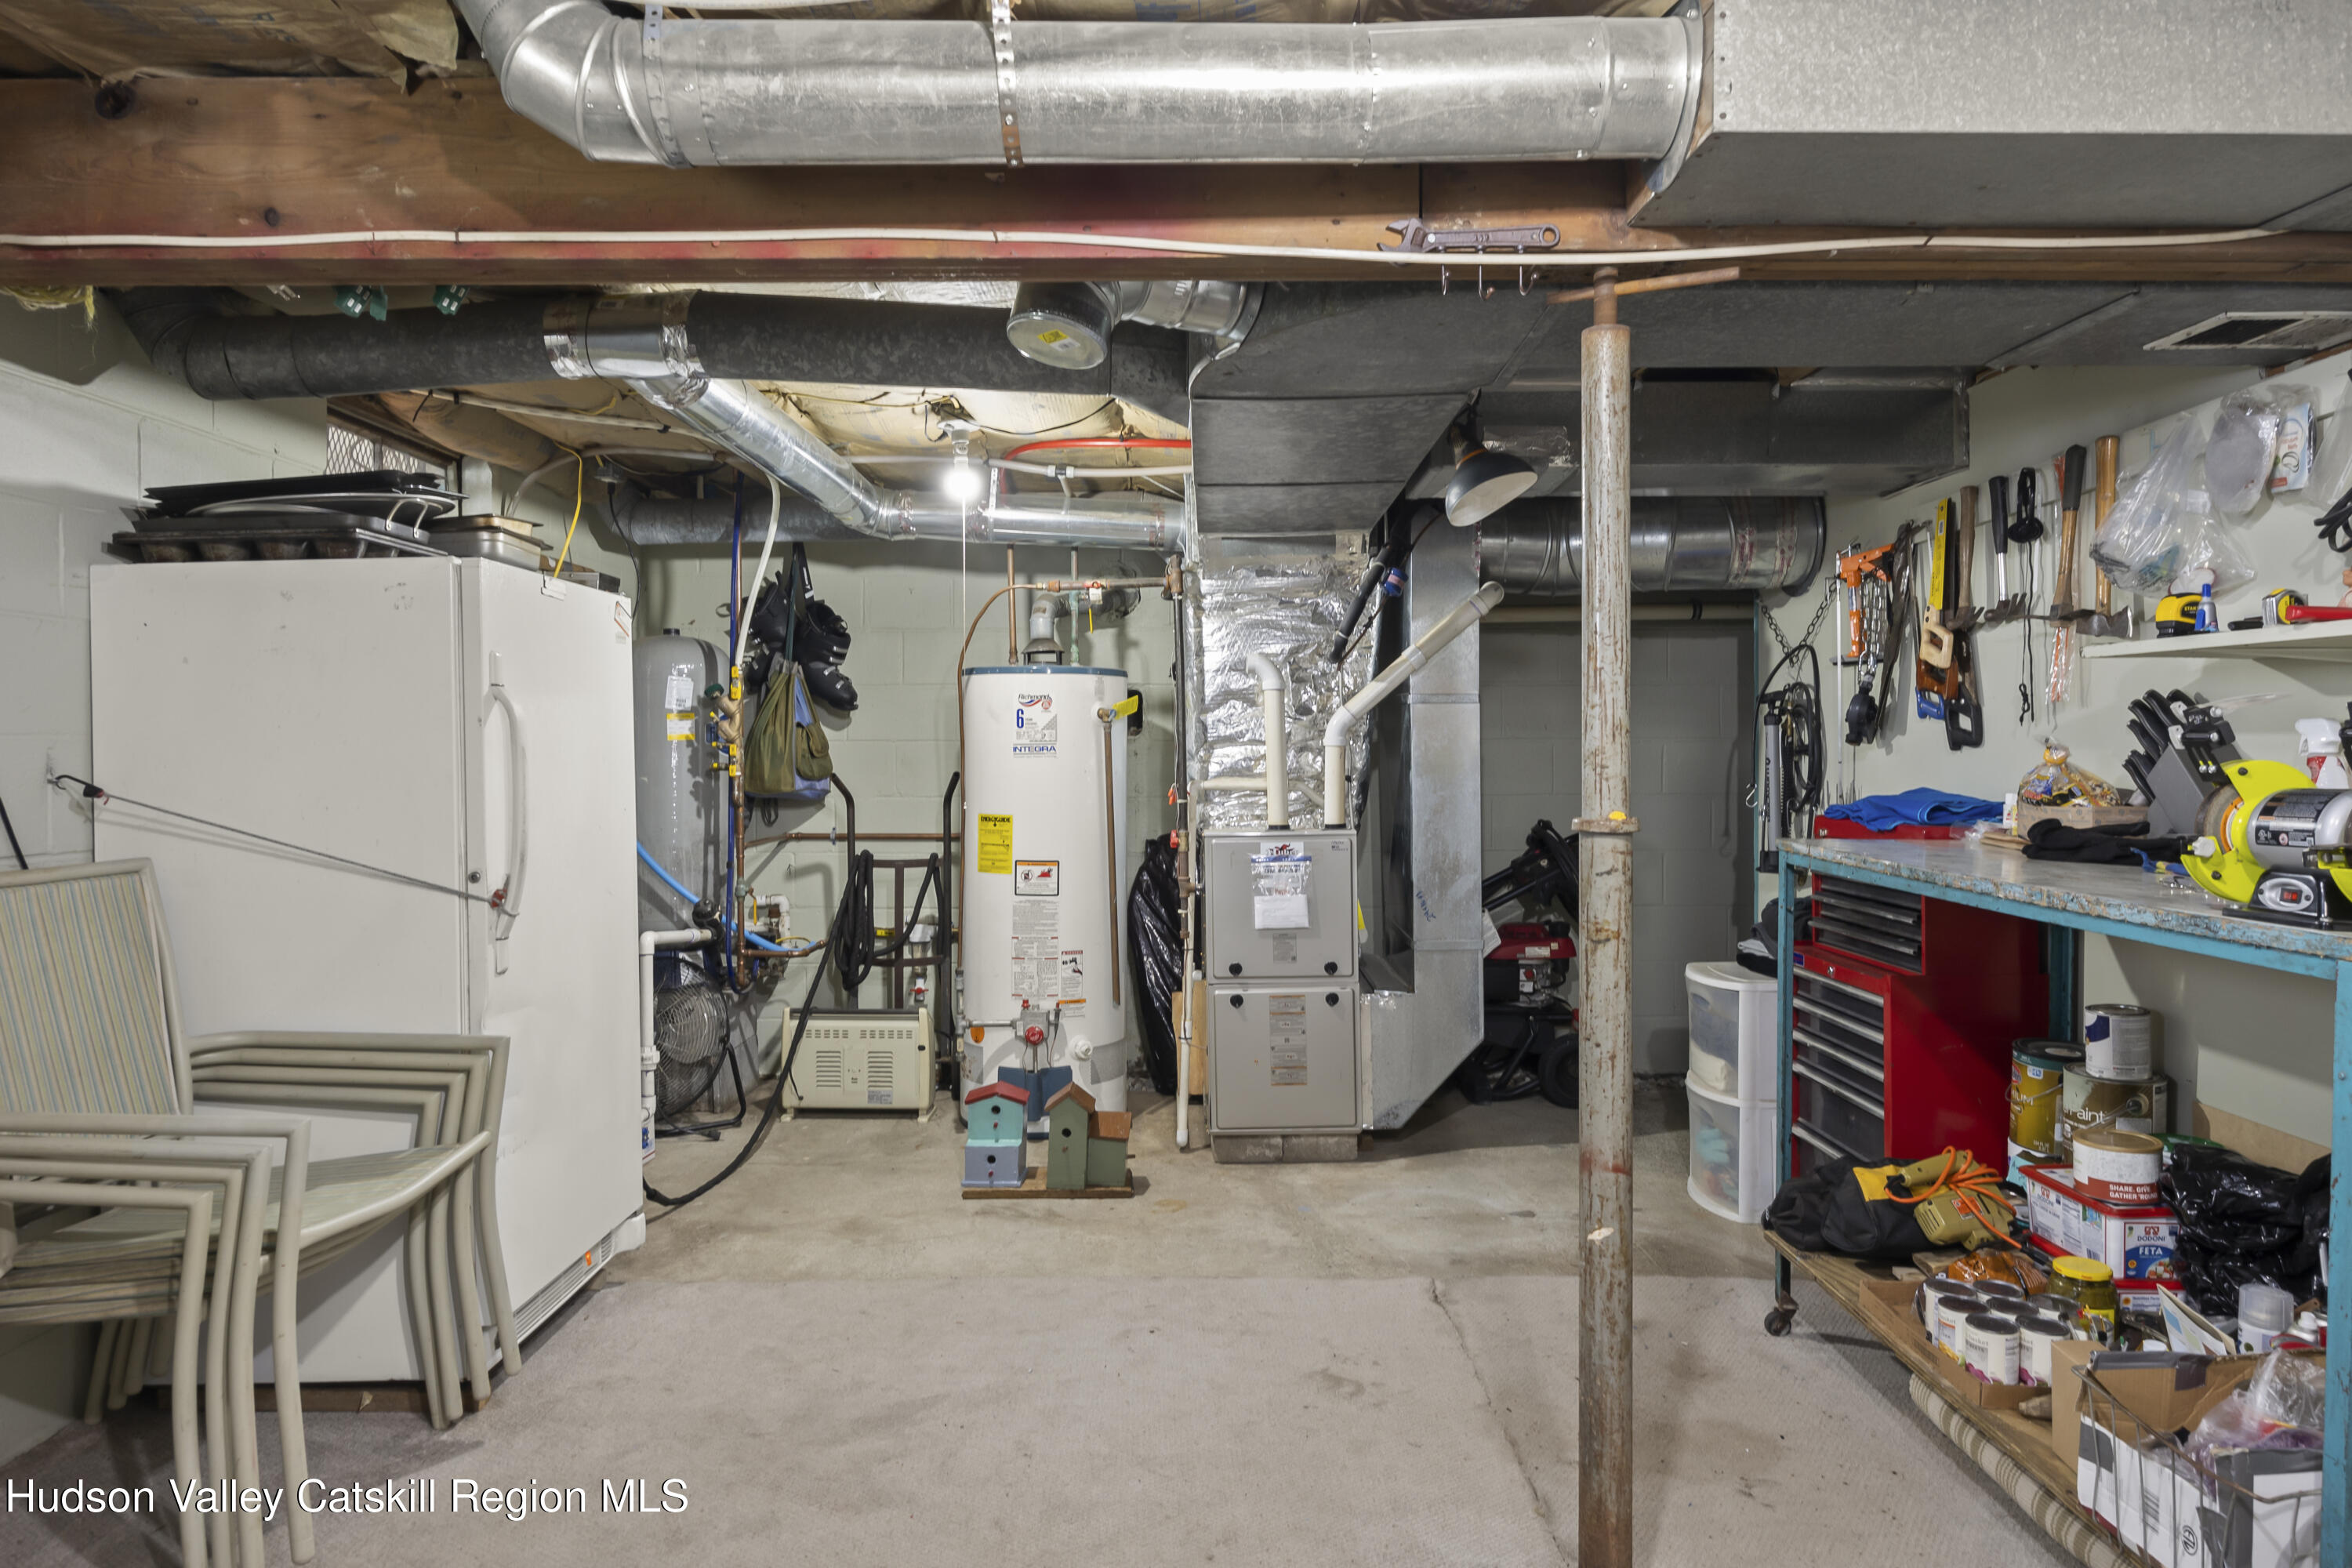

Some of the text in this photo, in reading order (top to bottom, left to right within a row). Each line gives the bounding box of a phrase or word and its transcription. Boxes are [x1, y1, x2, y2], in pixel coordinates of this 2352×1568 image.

[1016, 708, 1024, 728] 6
[2109, 1192, 2137, 1200] GATHER
[2139, 1247, 2163, 1255] FETA
